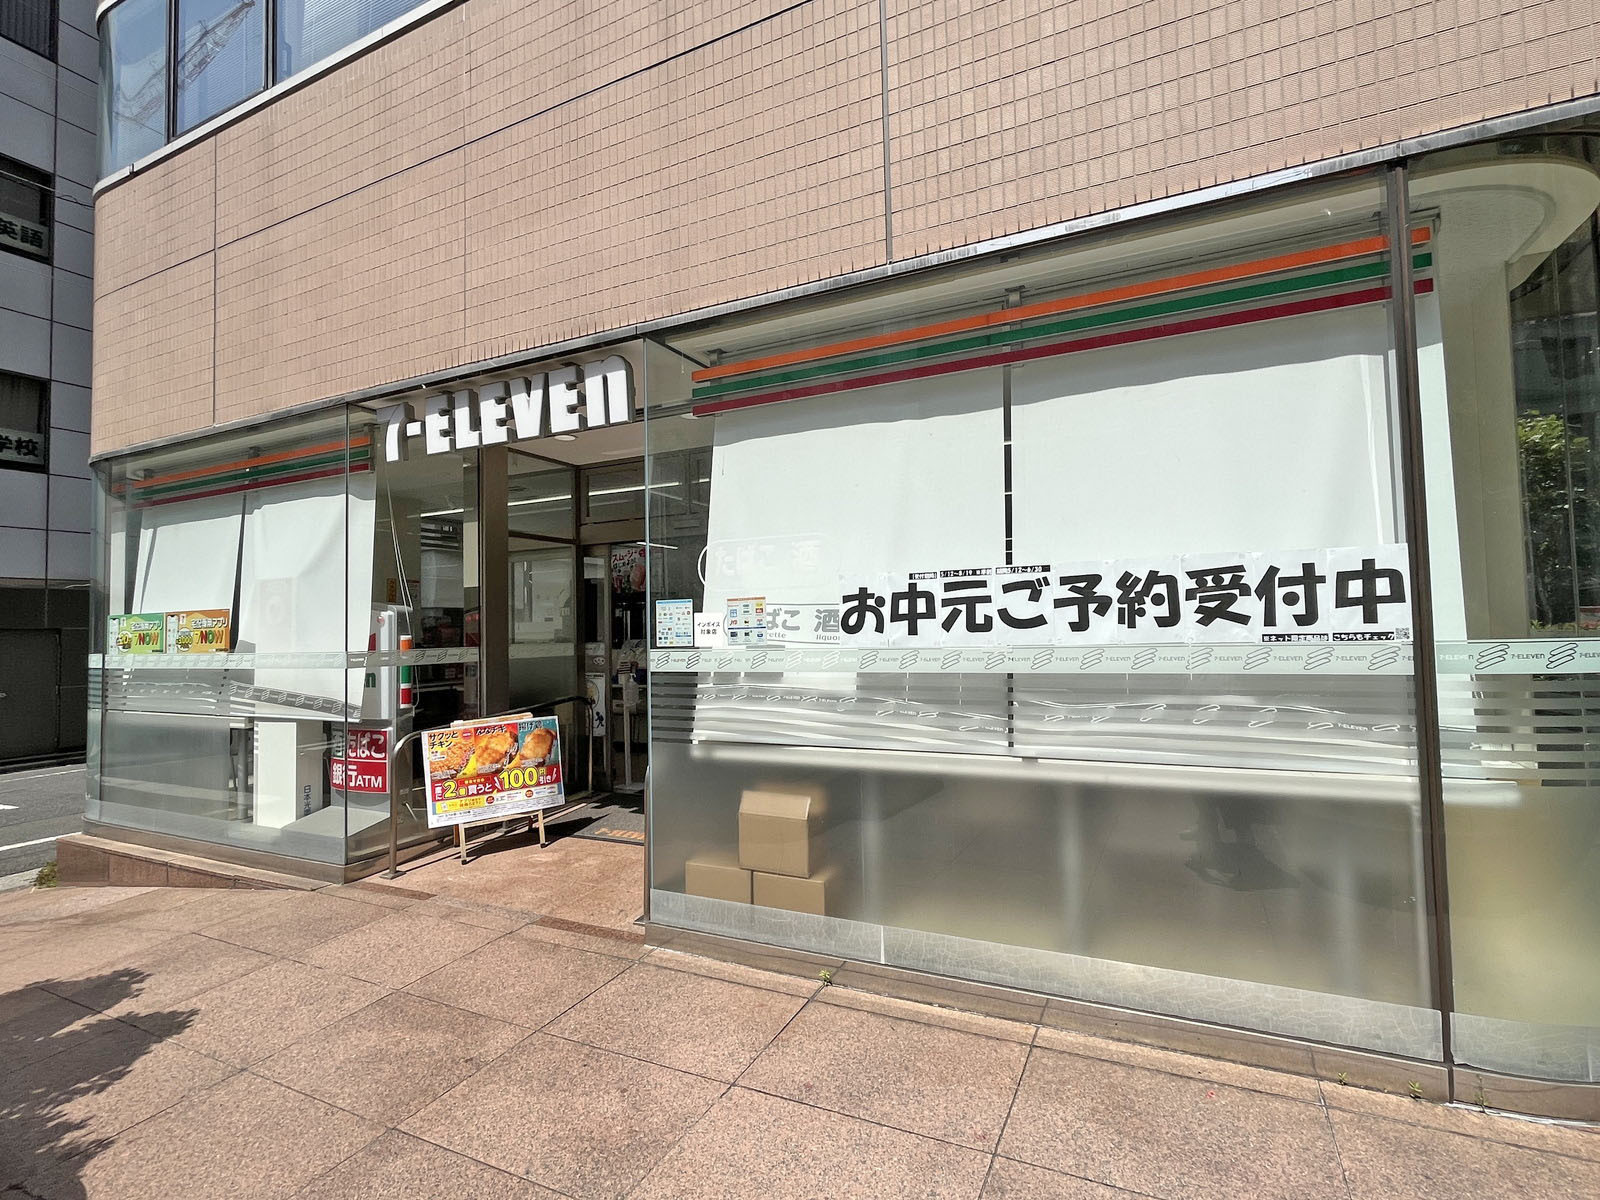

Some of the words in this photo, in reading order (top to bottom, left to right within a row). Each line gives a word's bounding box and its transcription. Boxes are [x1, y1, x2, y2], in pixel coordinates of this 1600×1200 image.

[0, 218, 43, 249] 英語
[840, 558, 1406, 636] お中元ご予約受付中
[697, 620, 721, 628] インボイス
[192, 629, 224, 645] 7NOW
[428, 731, 459, 742] サクッと
[428, 741, 453, 750] チキン
